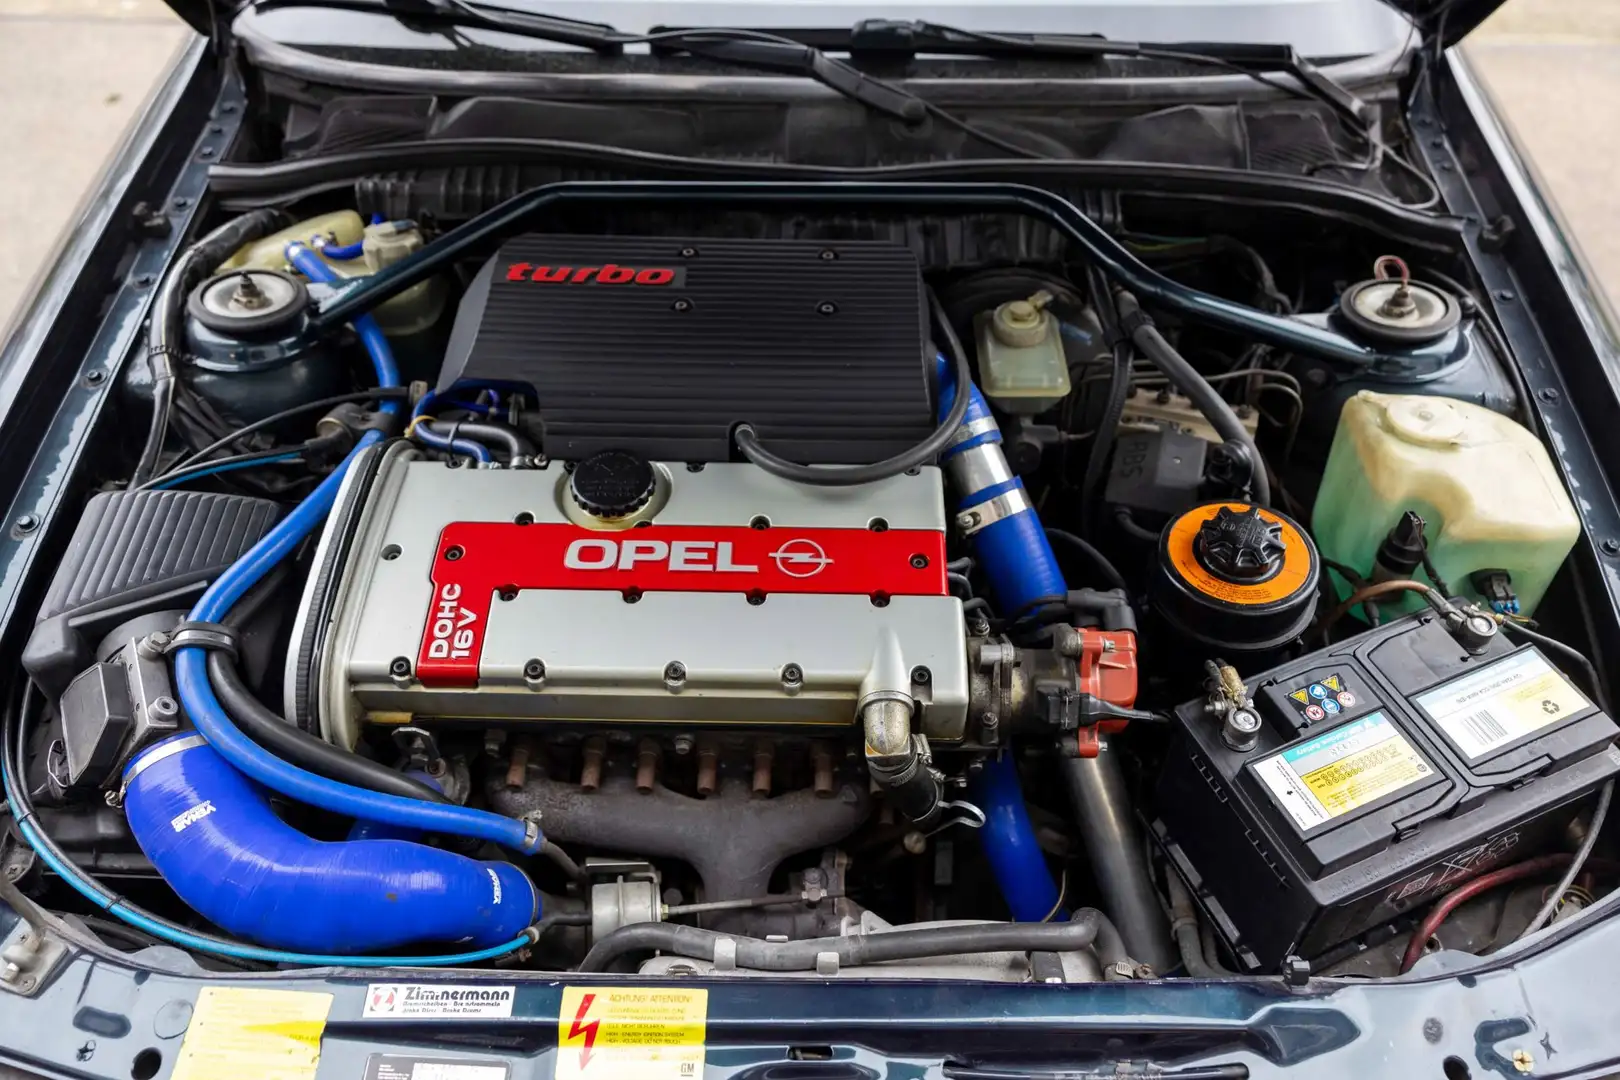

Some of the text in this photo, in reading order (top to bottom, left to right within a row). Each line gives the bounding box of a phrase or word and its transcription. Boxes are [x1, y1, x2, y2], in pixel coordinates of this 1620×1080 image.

[506, 261, 676, 285] turbo
[564, 538, 759, 573] OPEL
[428, 583, 462, 659] DOHC
[450, 607, 478, 660] 16V
[404, 987, 510, 1001] Zimmermann
[680, 1062, 695, 1073] GM
